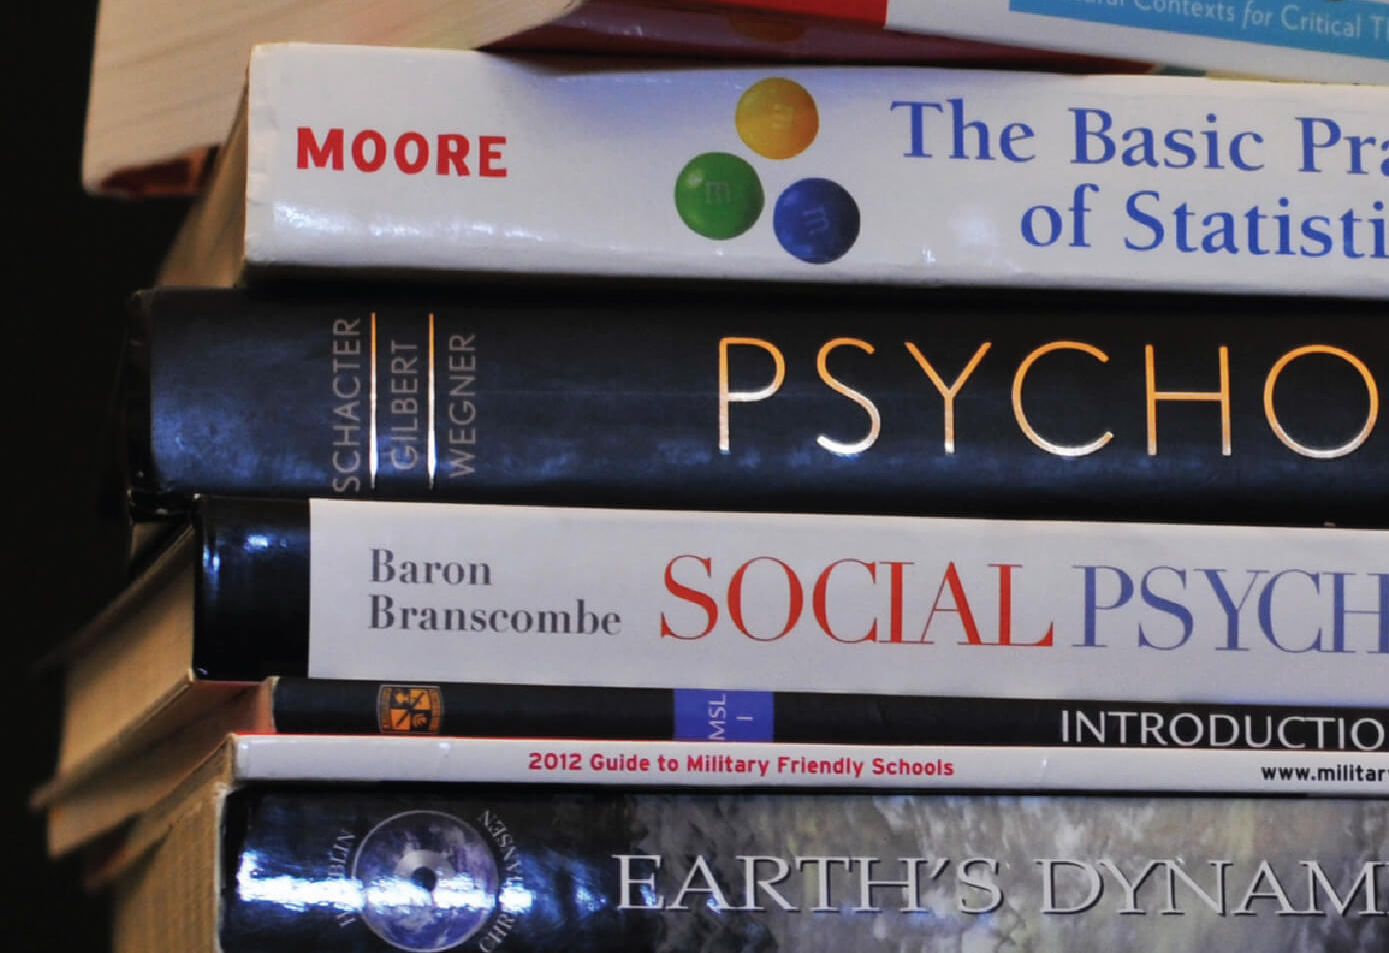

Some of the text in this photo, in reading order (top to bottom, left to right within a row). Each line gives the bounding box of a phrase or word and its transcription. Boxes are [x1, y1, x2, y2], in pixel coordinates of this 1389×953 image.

[1241, 0, 1272, 30] for
[1280, 5, 1361, 39] Critical
[297, 127, 508, 178] MOORE
[891, 98, 1036, 164] The
[1068, 107, 1264, 171] Basic
[1021, 183, 1099, 247] of
[333, 318, 361, 493] SCHACTER
[391, 340, 418, 470] GILBERT
[450, 334, 476, 478] WEGNER
[368, 549, 493, 586] Baron
[368, 594, 622, 636] Branscombe
[660, 554, 1054, 647] SOCIAL
[708, 694, 727, 740] MSL
[528, 752, 954, 779] 2012 Guide to Military Friendly Schools
[611, 855, 1001, 914] EARTH'S
